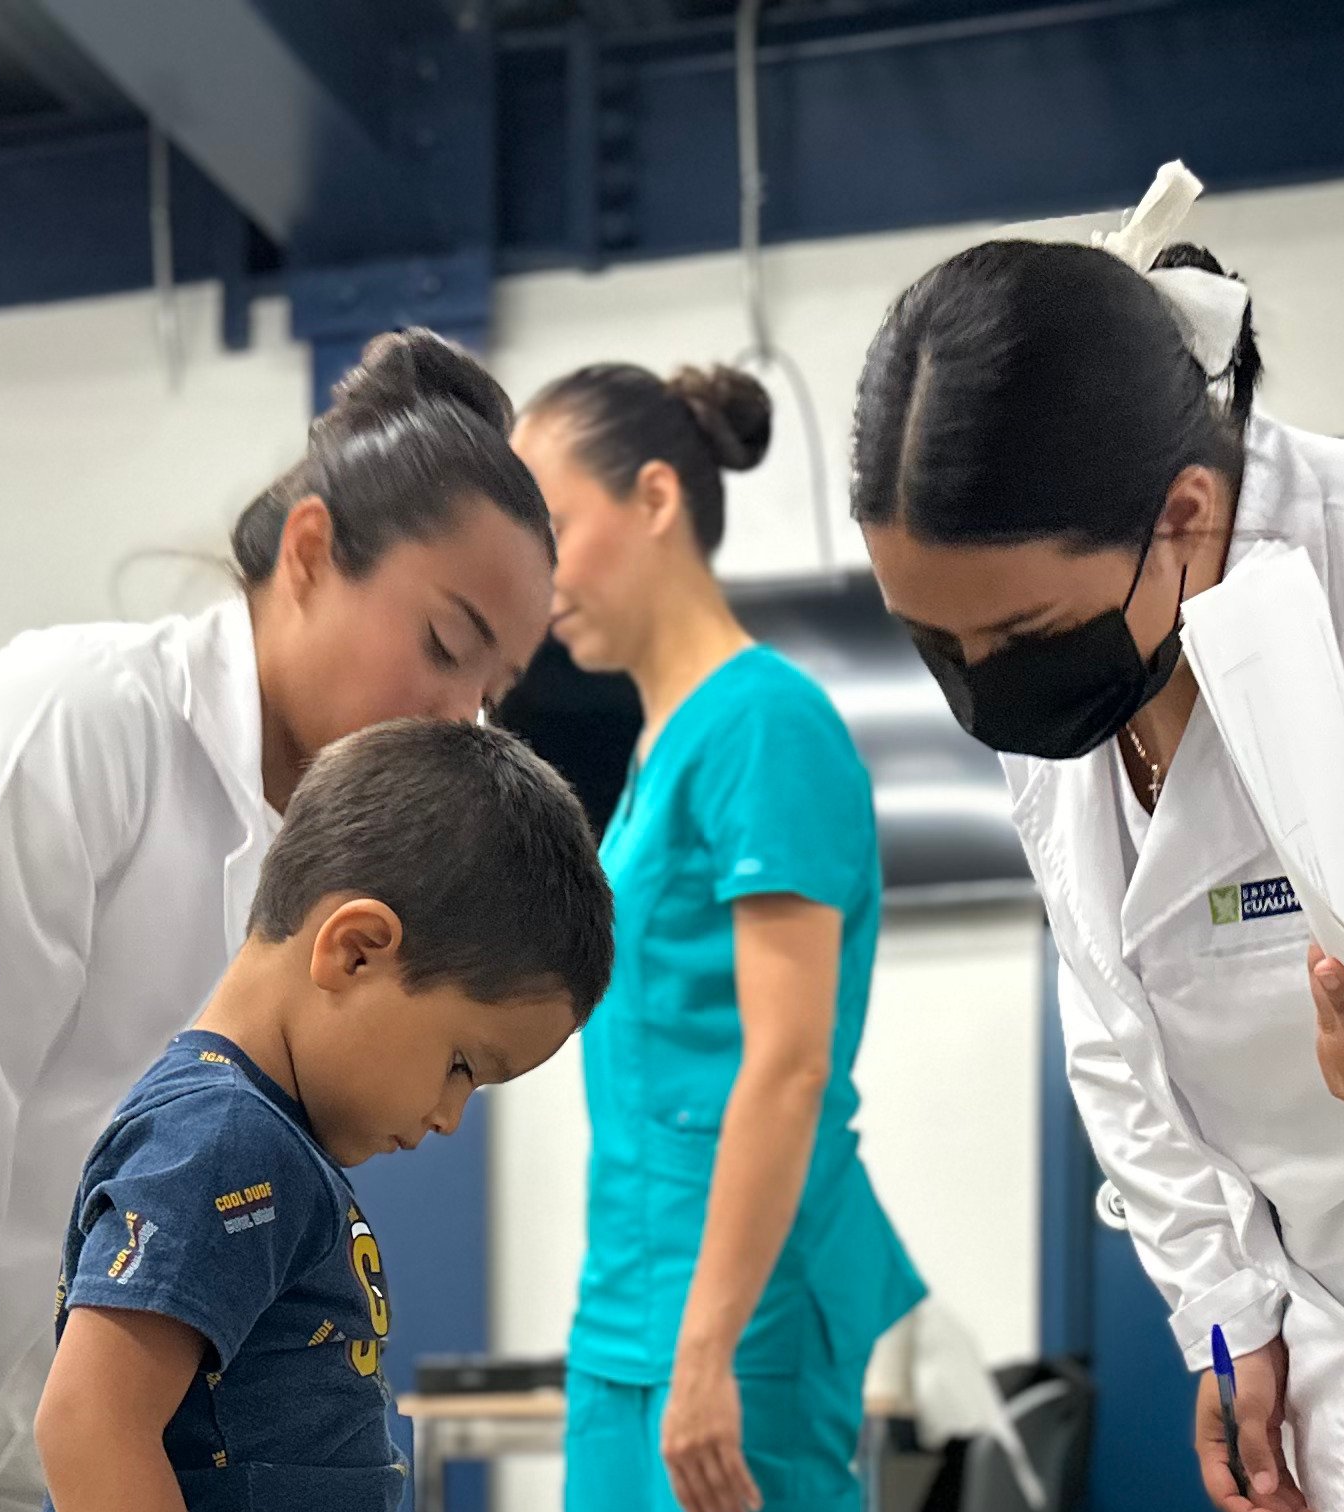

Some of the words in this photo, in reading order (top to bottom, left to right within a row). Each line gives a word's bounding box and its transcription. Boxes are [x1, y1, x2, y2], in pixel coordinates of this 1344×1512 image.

[214, 1190, 246, 1213] COOL
[243, 1181, 273, 1203] DUDE
[107, 1248, 133, 1278] COOL
